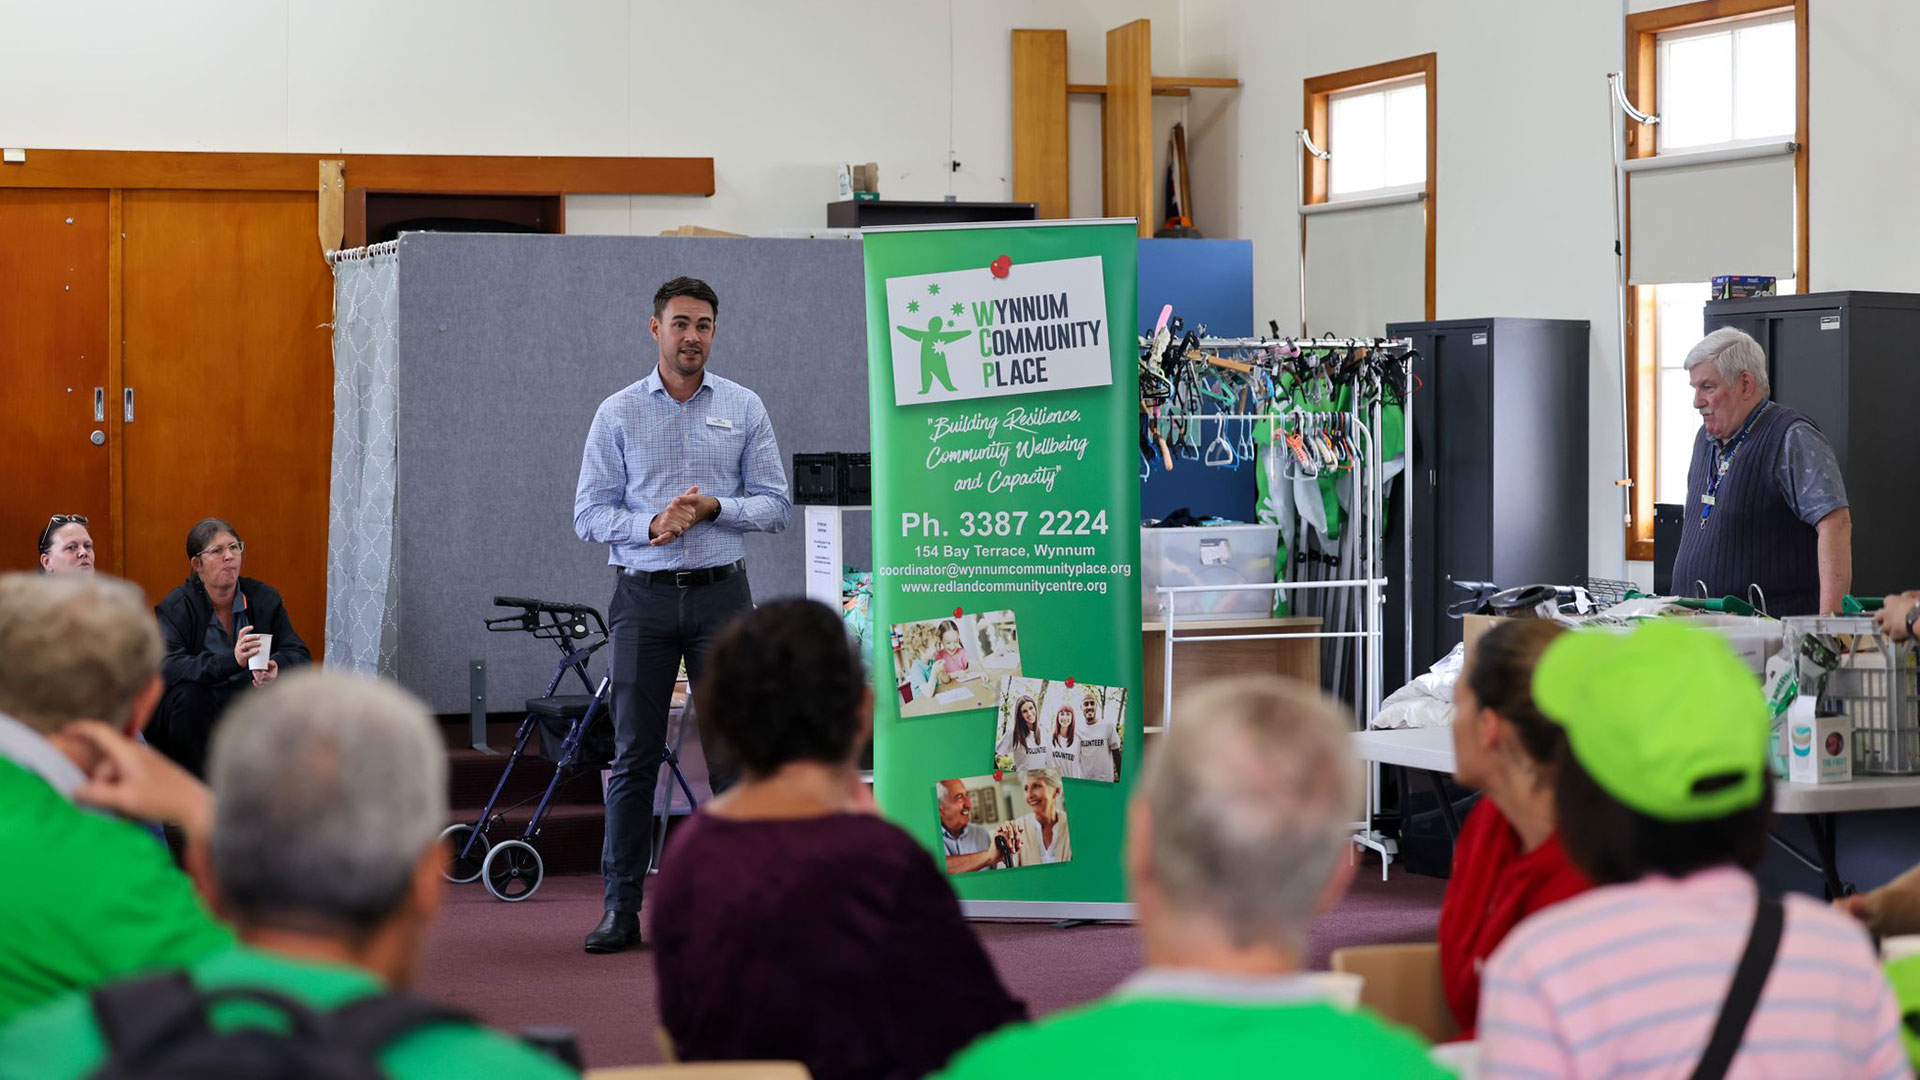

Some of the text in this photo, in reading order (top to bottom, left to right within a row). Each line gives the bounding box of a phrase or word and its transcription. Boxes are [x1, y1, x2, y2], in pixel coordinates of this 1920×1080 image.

[972, 292, 1068, 327] WYNNUM
[979, 320, 1101, 358] COMMUNITY
[983, 356, 1048, 388] PLACE
[927, 413, 1000, 442] "Building
[926, 434, 1089, 470] Community Wellbeing
[954, 465, 1061, 493] and Capacity"
[901, 510, 1109, 537] Ph. 3387 2224
[915, 544, 1096, 561] 154 Bay Terrace, Wynnum
[879, 562, 1131, 578] coordinator@wynnumcommunityplace.org
[901, 579, 1107, 594] www.redlandcommunitycentre.org
[1080, 739, 1104, 747] OLUNTEER
